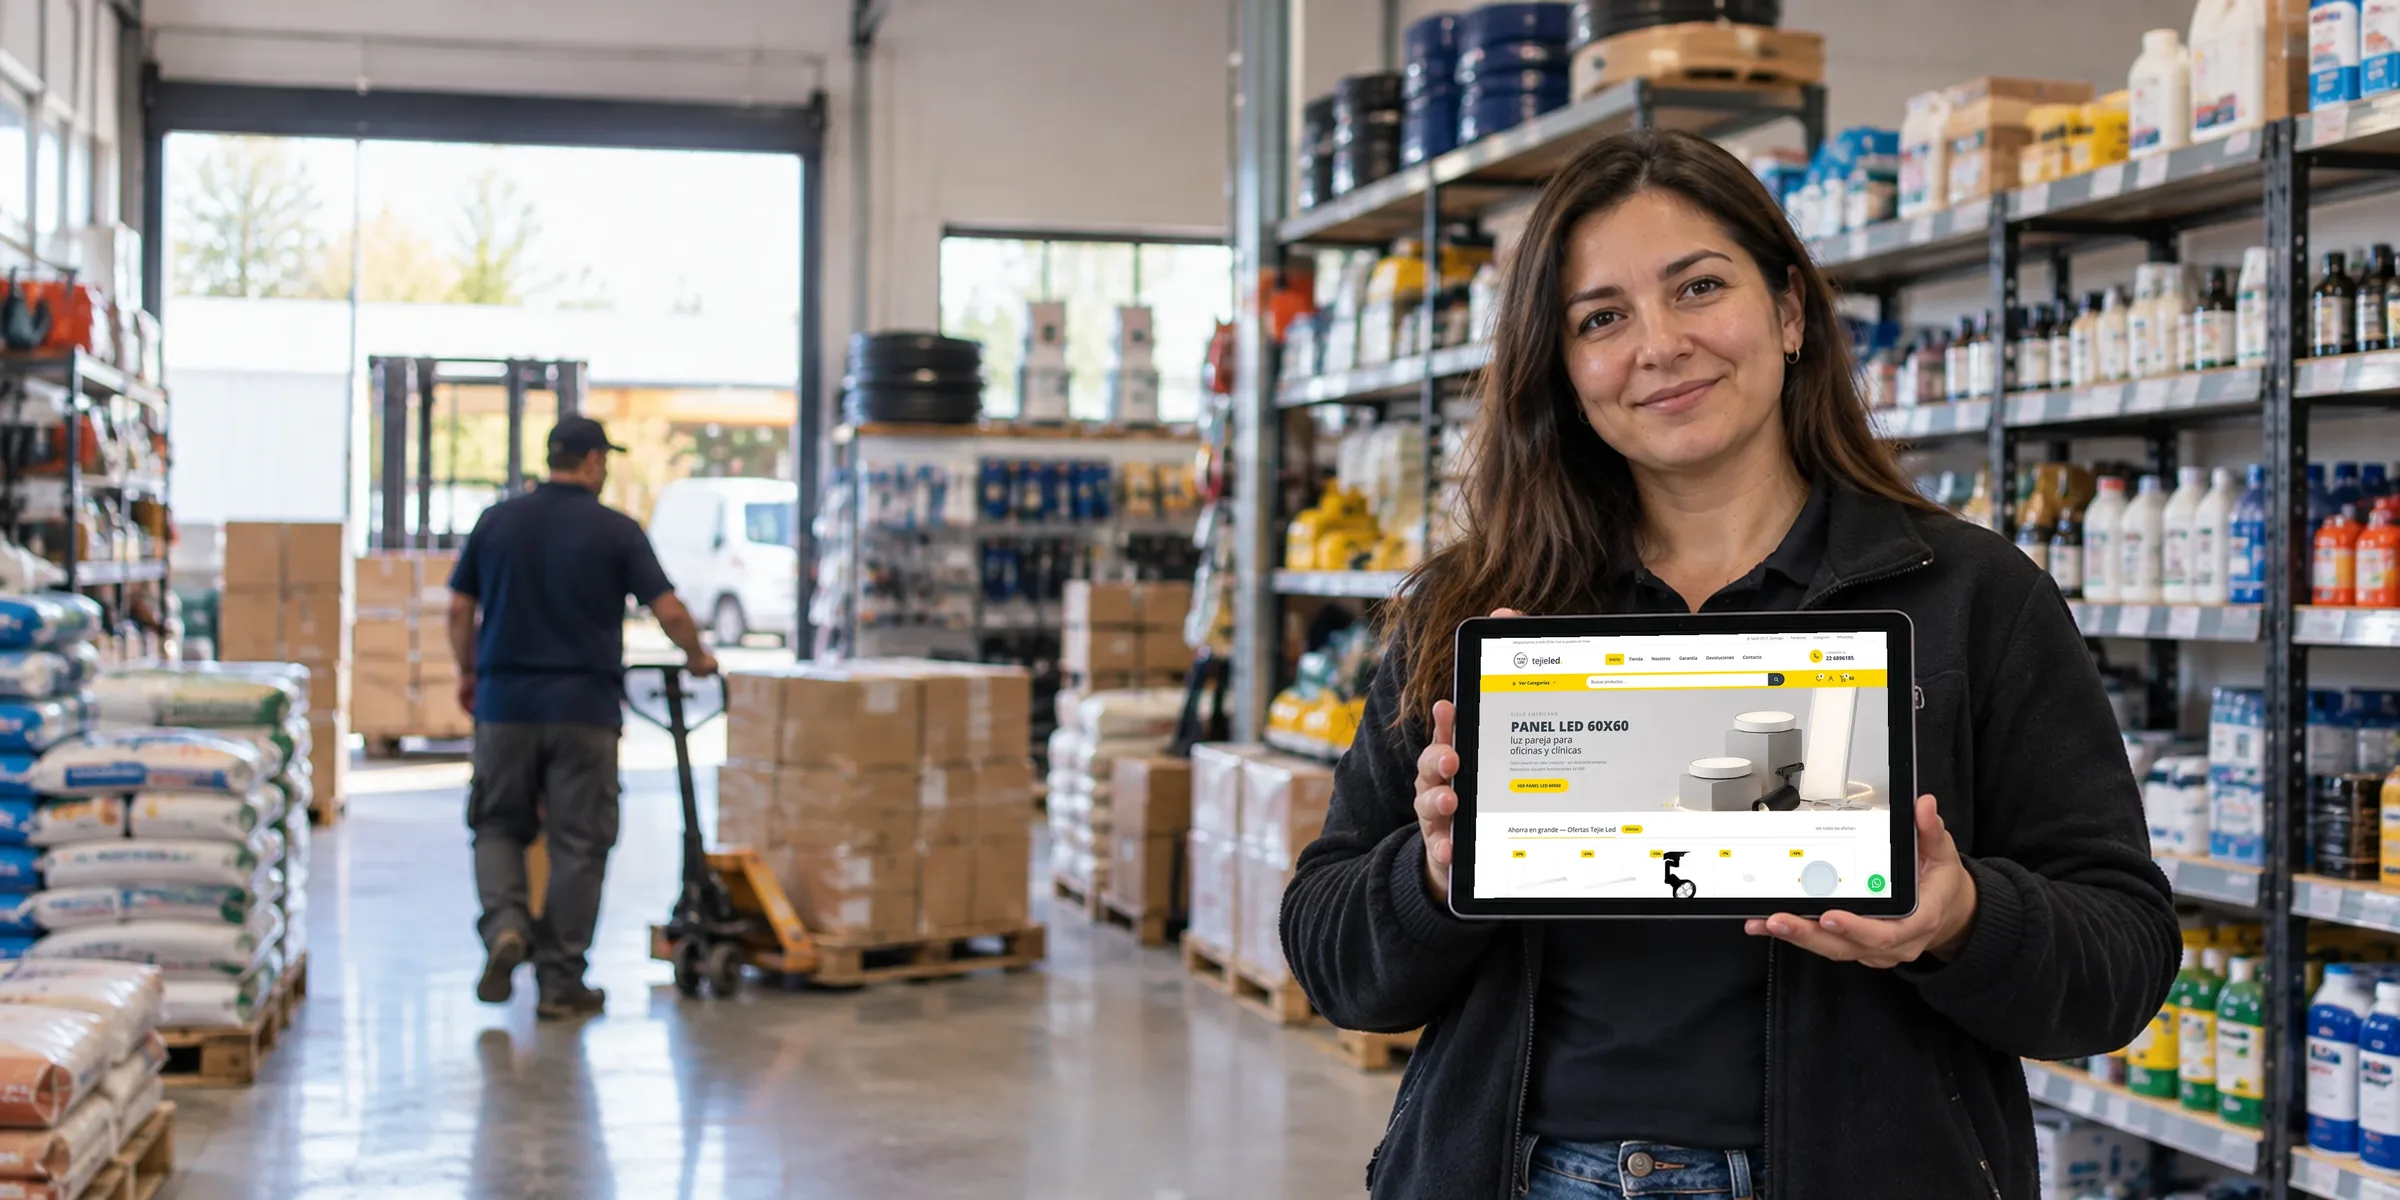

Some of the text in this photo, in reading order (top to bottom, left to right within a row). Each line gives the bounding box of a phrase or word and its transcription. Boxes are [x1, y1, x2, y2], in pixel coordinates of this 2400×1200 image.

[1511, 720, 1629, 733] PANEL LED 60X60
[1510, 736, 1573, 746] luz pareja para
[1510, 746, 1582, 756] oficinas y clínicas
[1537, 826, 1559, 834] grande
[1590, 826, 1605, 834] Tejie
